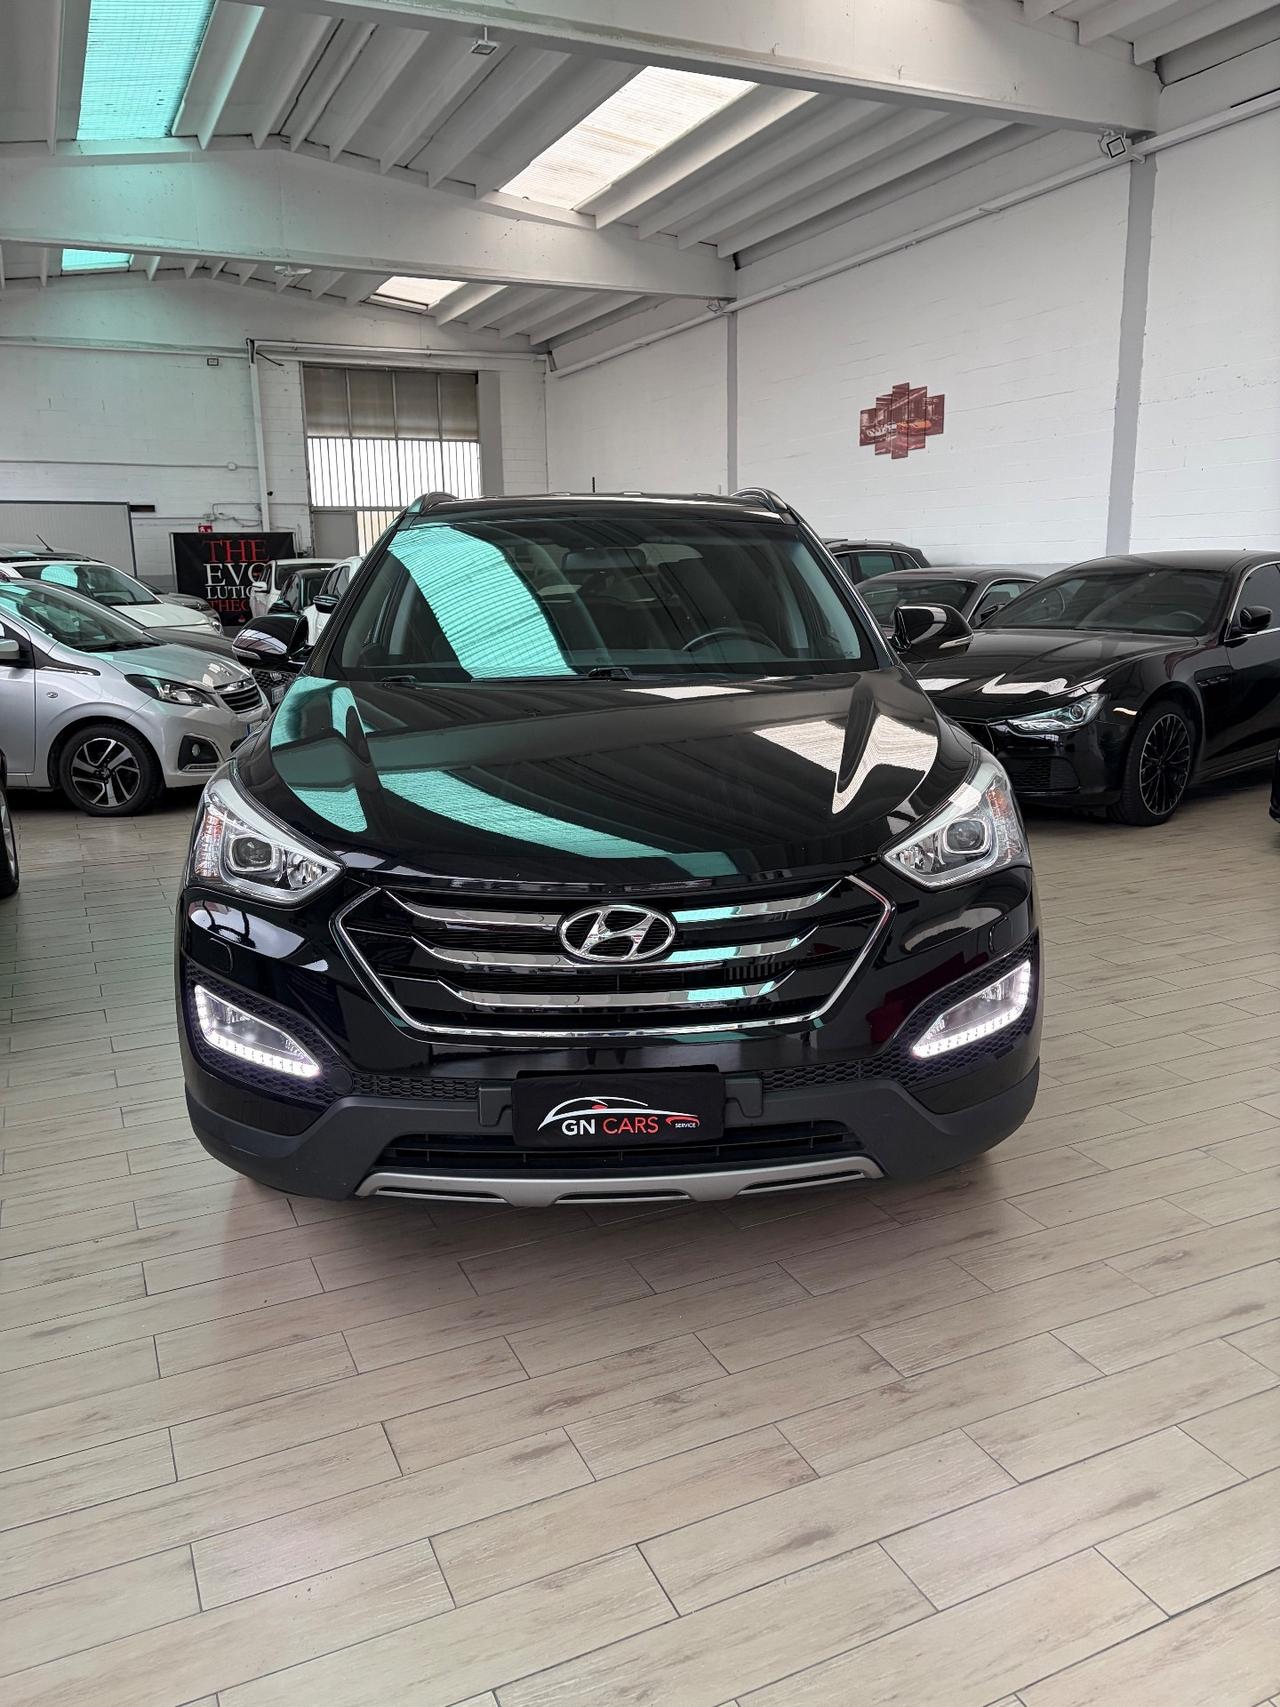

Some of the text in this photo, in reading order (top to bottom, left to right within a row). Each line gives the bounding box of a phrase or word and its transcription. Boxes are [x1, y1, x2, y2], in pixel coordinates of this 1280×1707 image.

[203, 540, 270, 562] THE
[561, 1116, 659, 1136] GN CARS
